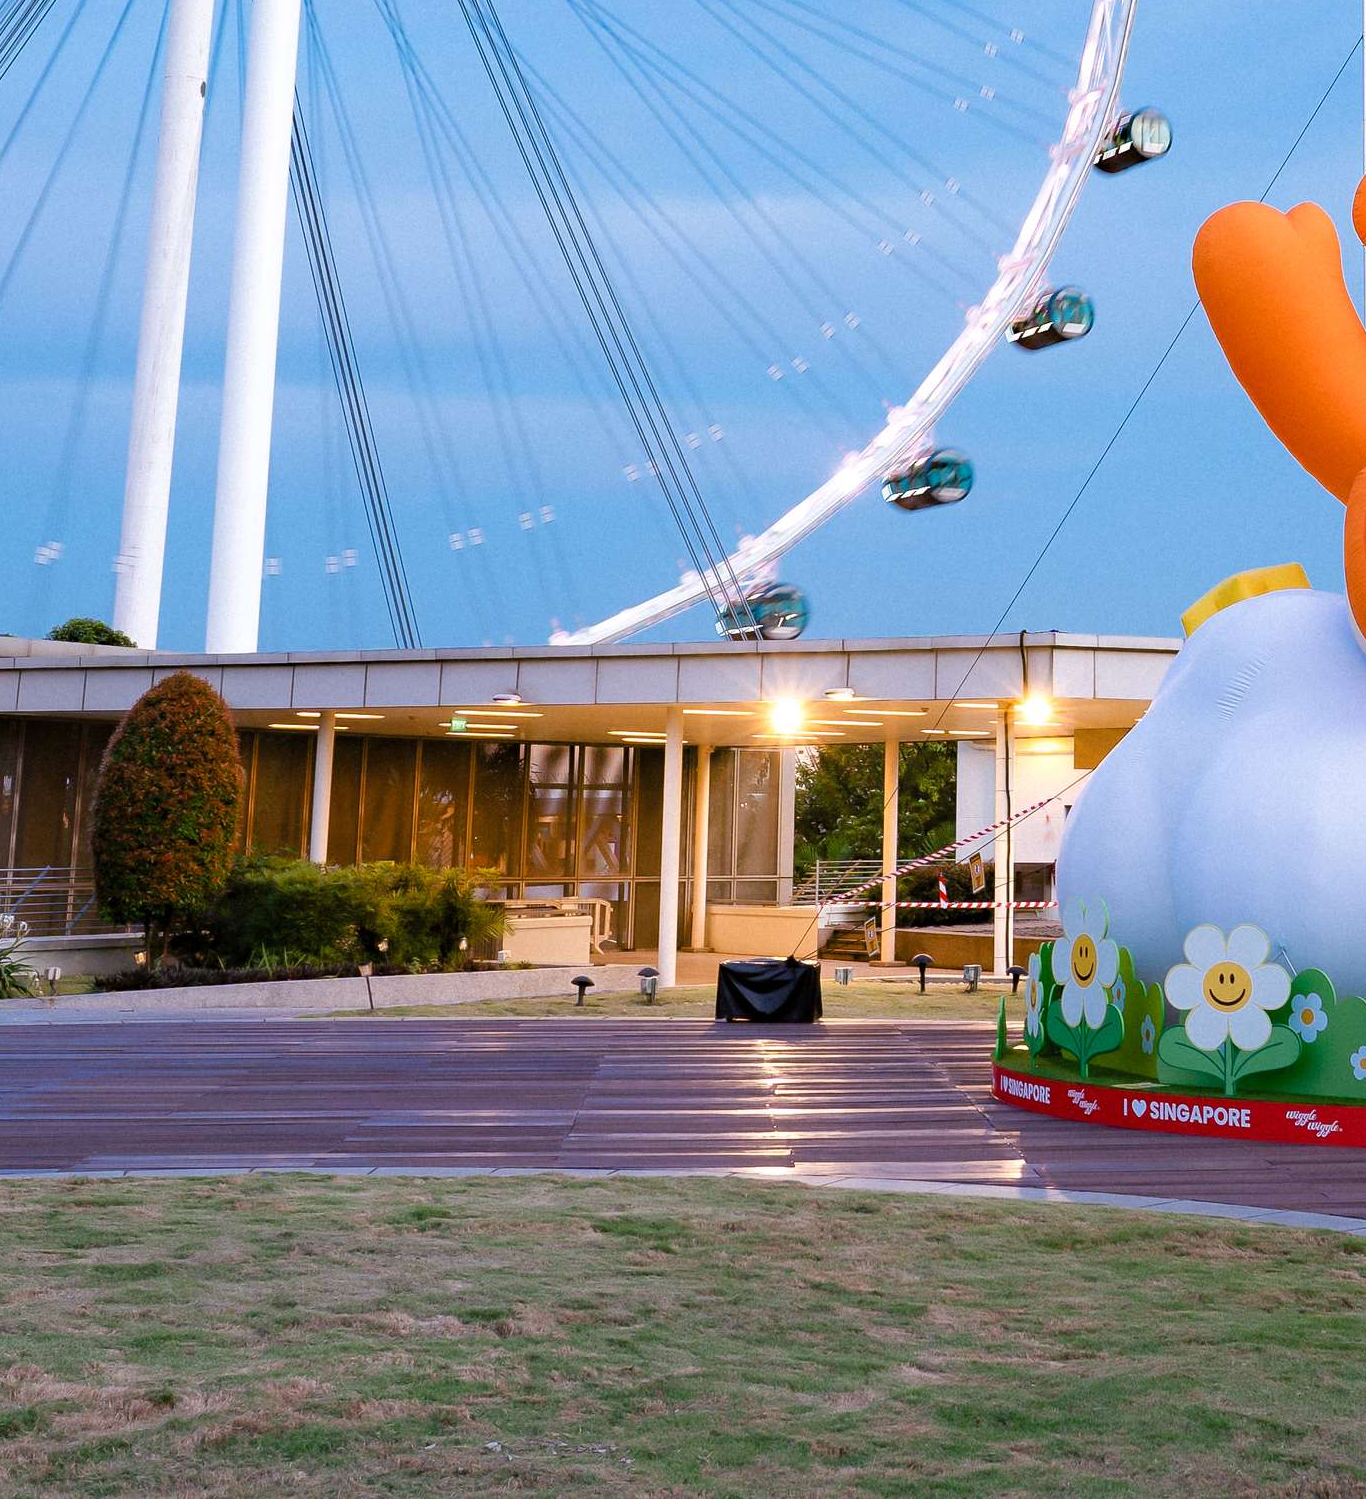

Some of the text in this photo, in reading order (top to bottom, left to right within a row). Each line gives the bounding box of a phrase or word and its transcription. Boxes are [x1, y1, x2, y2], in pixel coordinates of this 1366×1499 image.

[1008, 1078, 1051, 1105] SINGAPORE
[1123, 1098, 1251, 1128] I SINGAPORE
